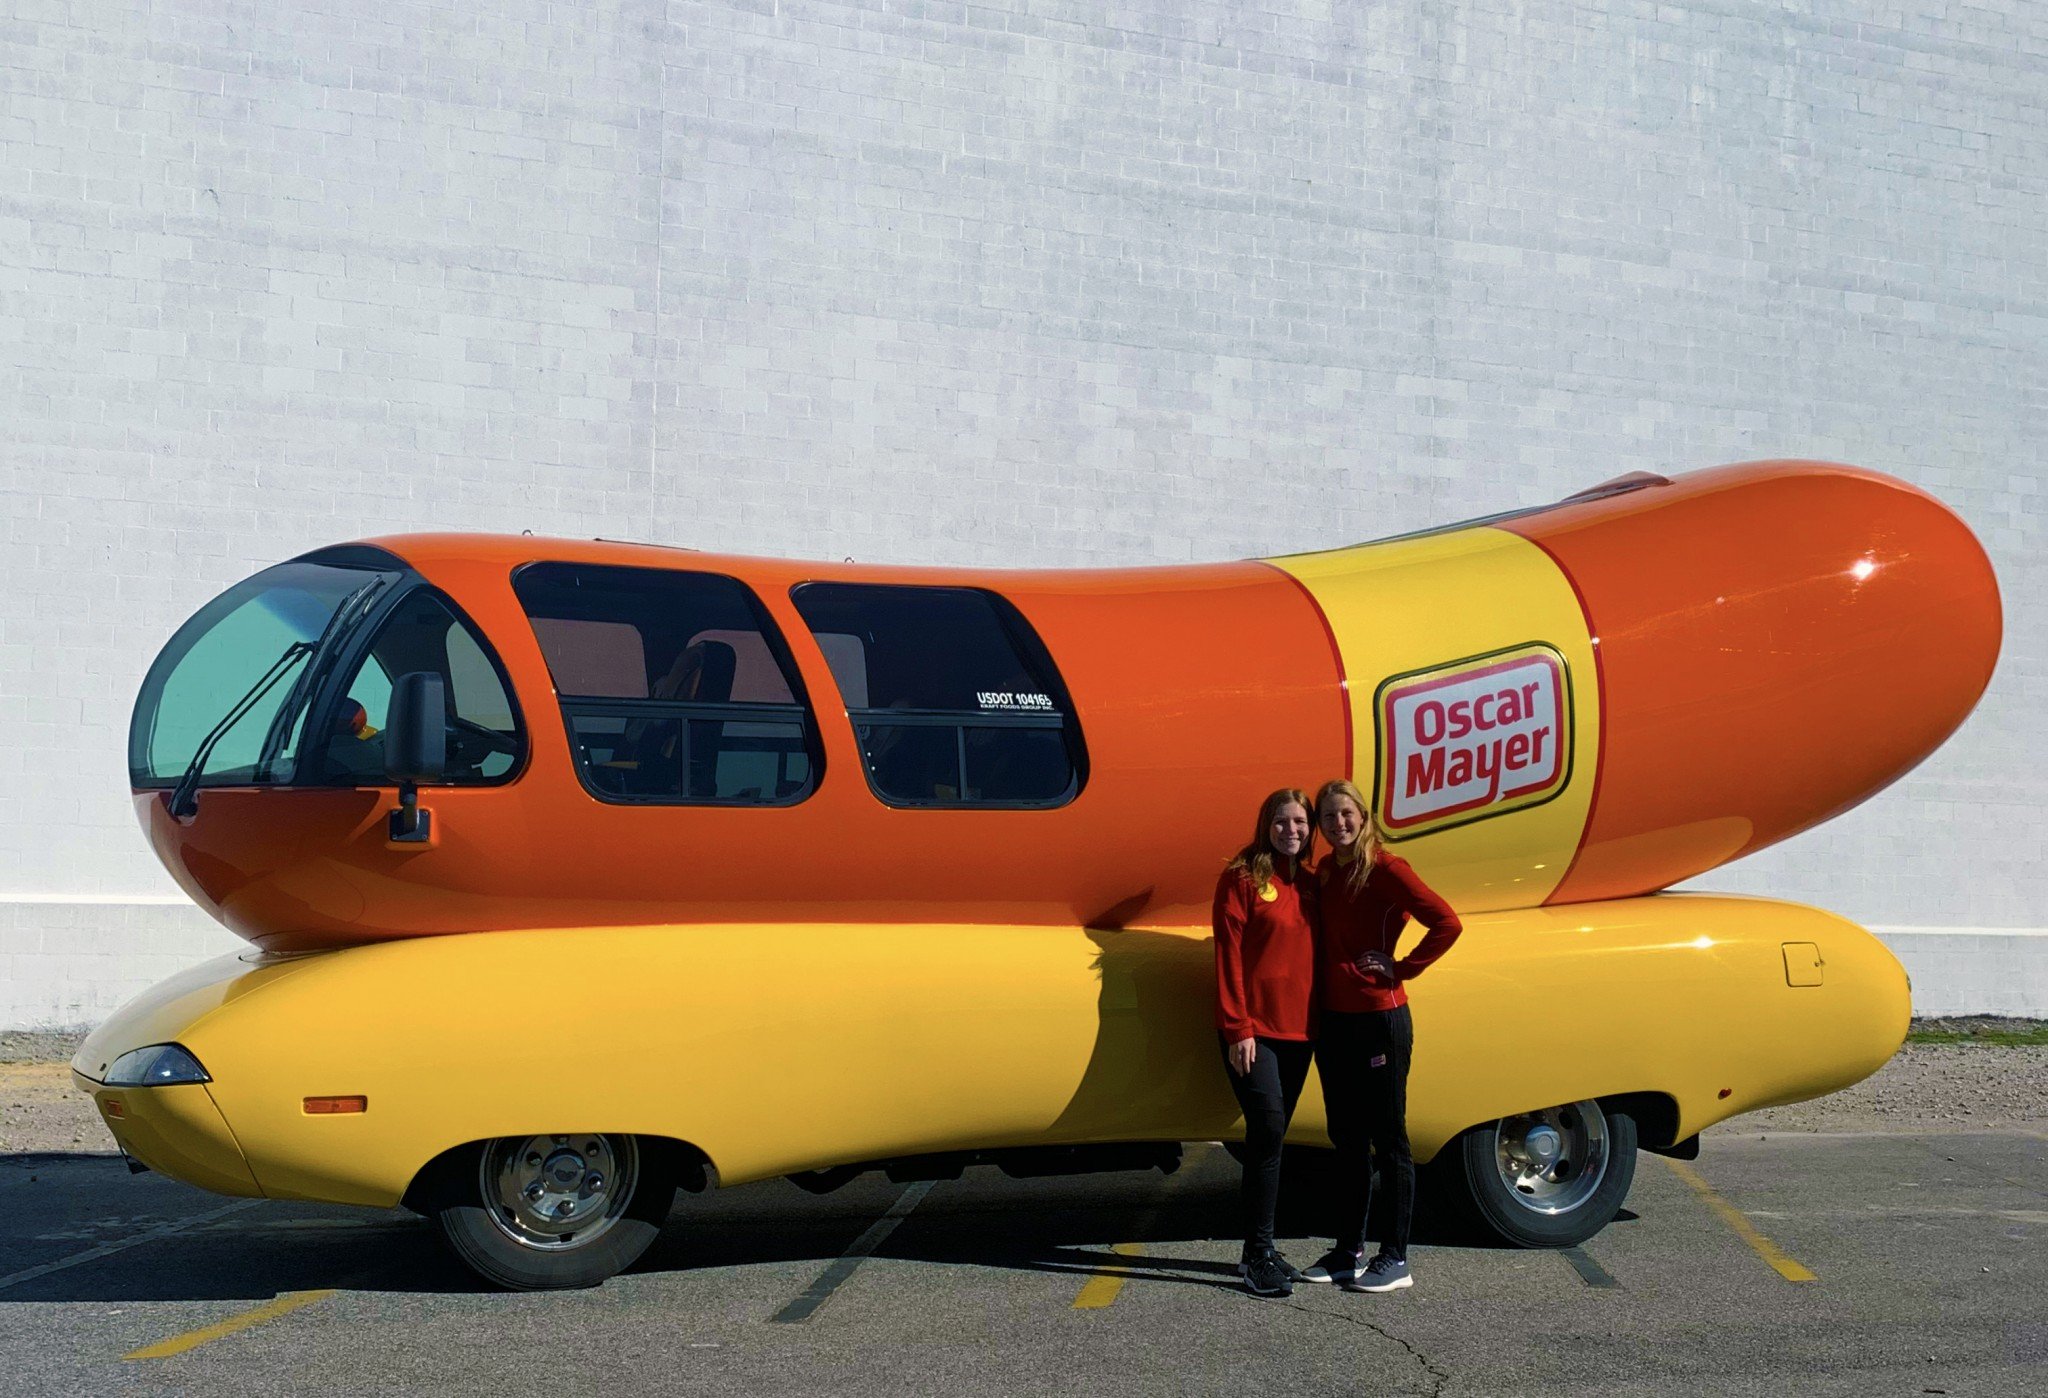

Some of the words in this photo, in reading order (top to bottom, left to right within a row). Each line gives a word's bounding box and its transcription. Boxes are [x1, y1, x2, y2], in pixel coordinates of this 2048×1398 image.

[977, 691, 1013, 704] USDOT
[1015, 693, 1052, 705] 104165
[1414, 681, 1540, 746] Oscar
[1405, 726, 1550, 800] Mayer
